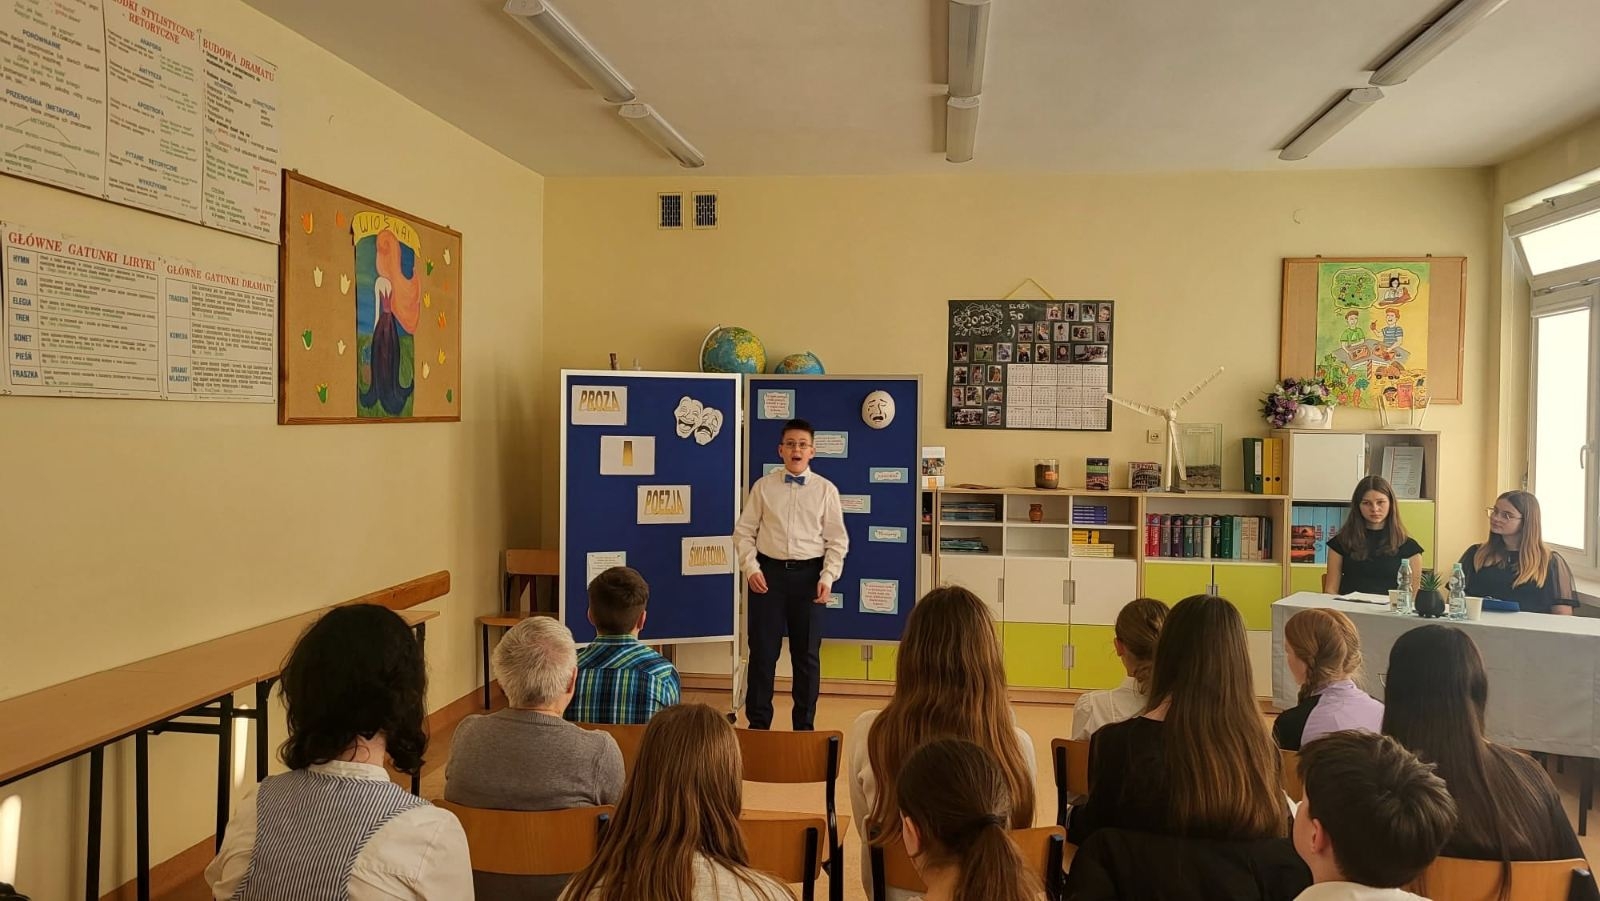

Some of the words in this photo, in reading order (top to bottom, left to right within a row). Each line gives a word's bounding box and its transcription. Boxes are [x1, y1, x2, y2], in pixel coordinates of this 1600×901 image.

[111, 0, 138, 11] ODKI
[141, 6, 195, 40] STYLISTYCZNE
[129, 12, 180, 44] RETORYCZNE
[22, 29, 61, 50] PORÓWNANIE
[203, 38, 237, 64] BUDOWA
[240, 57, 275, 82] DRAMATU
[8, 232, 63, 252] GŁÓWNE
[68, 243, 118, 264] GATUNKI
[122, 254, 156, 271] LIRYKI
[13, 254, 30, 265] HYMN
[16, 277, 28, 286] ODA
[166, 264, 202, 279] GŁÓWNE
[205, 271, 239, 286] GATUNKI
[242, 279, 274, 292] DRAMATU
[13, 296, 31, 307] ELEGIA
[16, 313, 29, 322] TREN
[14, 333, 32, 343] SONET
[12, 369, 39, 379] FRASZKA
[579, 390, 621, 412] PROZA
[644, 489, 685, 515] POEZJA
